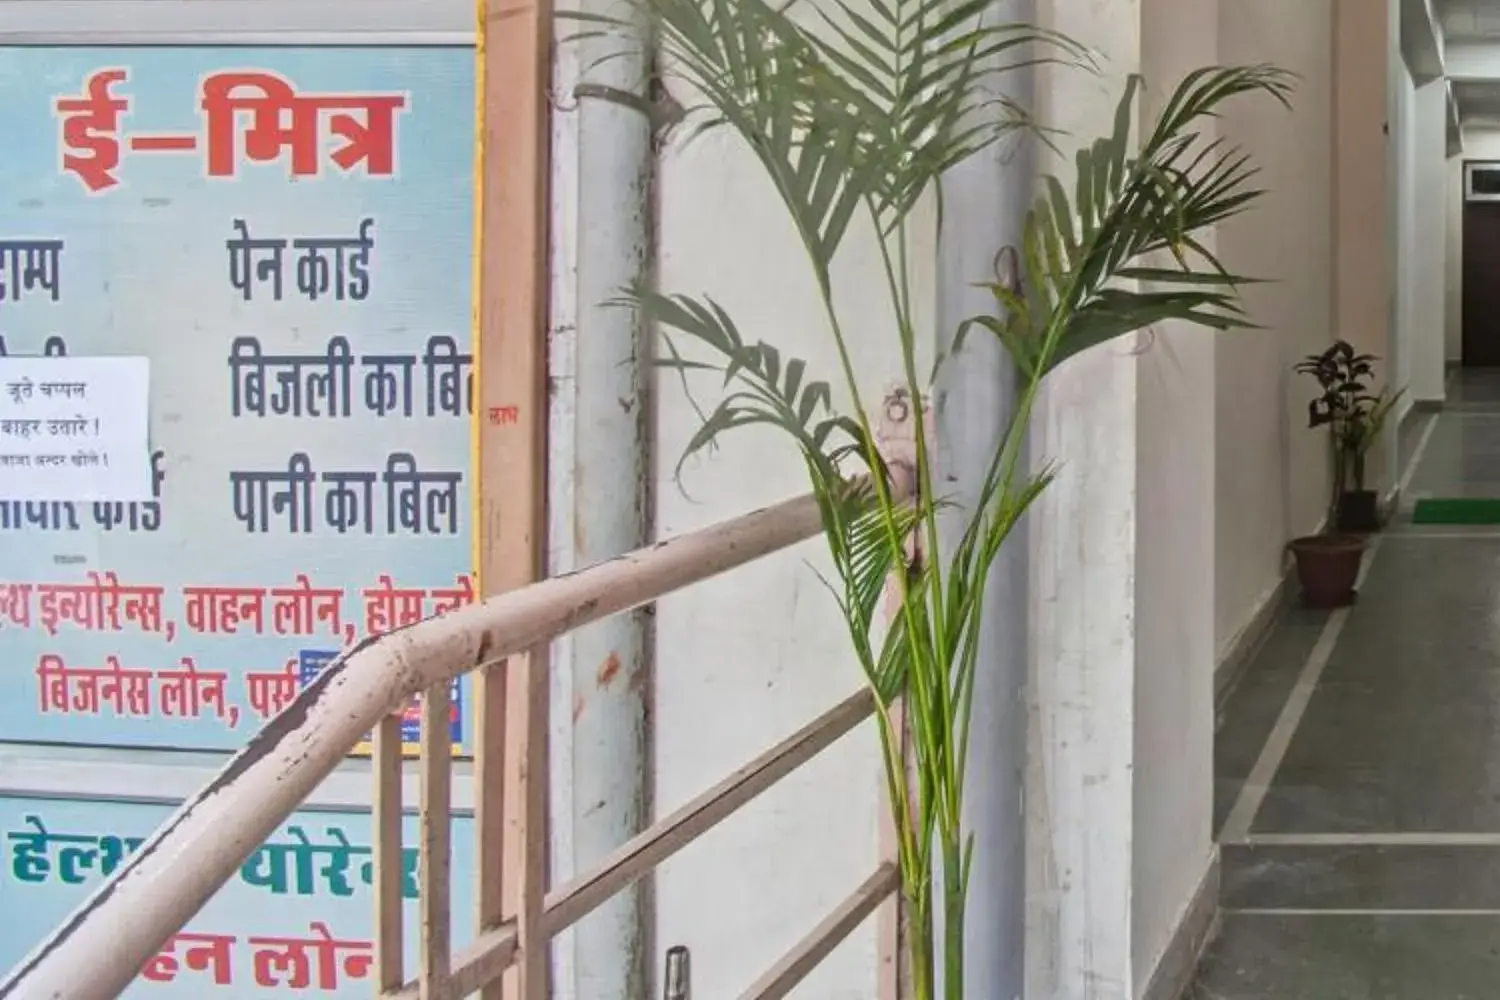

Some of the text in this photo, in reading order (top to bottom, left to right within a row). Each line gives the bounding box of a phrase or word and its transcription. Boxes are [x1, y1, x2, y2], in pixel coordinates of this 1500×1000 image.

[226, 219, 374, 301] पेन कार्ड
[228, 336, 355, 418] बिजली
[362, 355, 416, 417] का
[230, 453, 462, 534] पानी का बिल
[183, 588, 267, 634] वाहन
[272, 575, 355, 646] लोन,
[364, 575, 426, 635] होम
[37, 656, 153, 713] बिजनेस
[157, 658, 239, 728] लोन,
